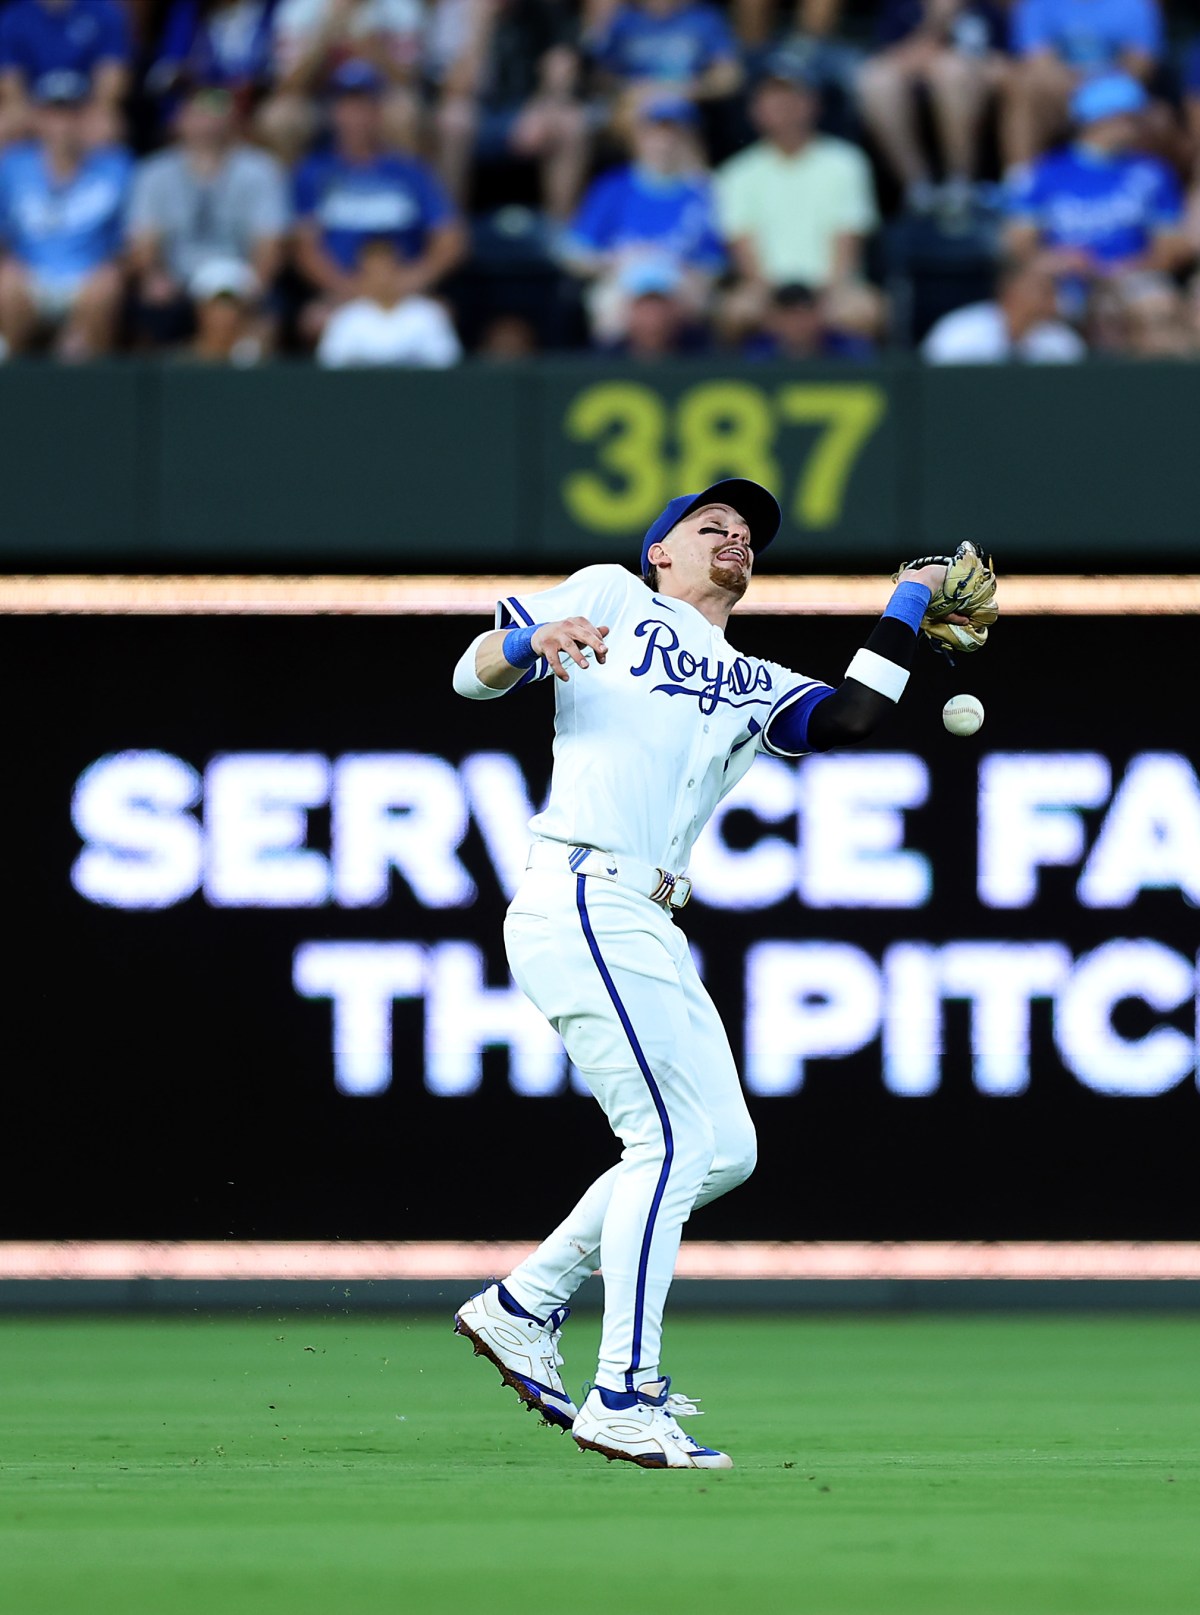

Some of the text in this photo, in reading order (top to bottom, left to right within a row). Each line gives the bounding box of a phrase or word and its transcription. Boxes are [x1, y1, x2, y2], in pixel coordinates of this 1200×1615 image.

[564, 382, 886, 532] 387
[70, 748, 935, 911] SERVCE
[292, 938, 704, 1099] TH
